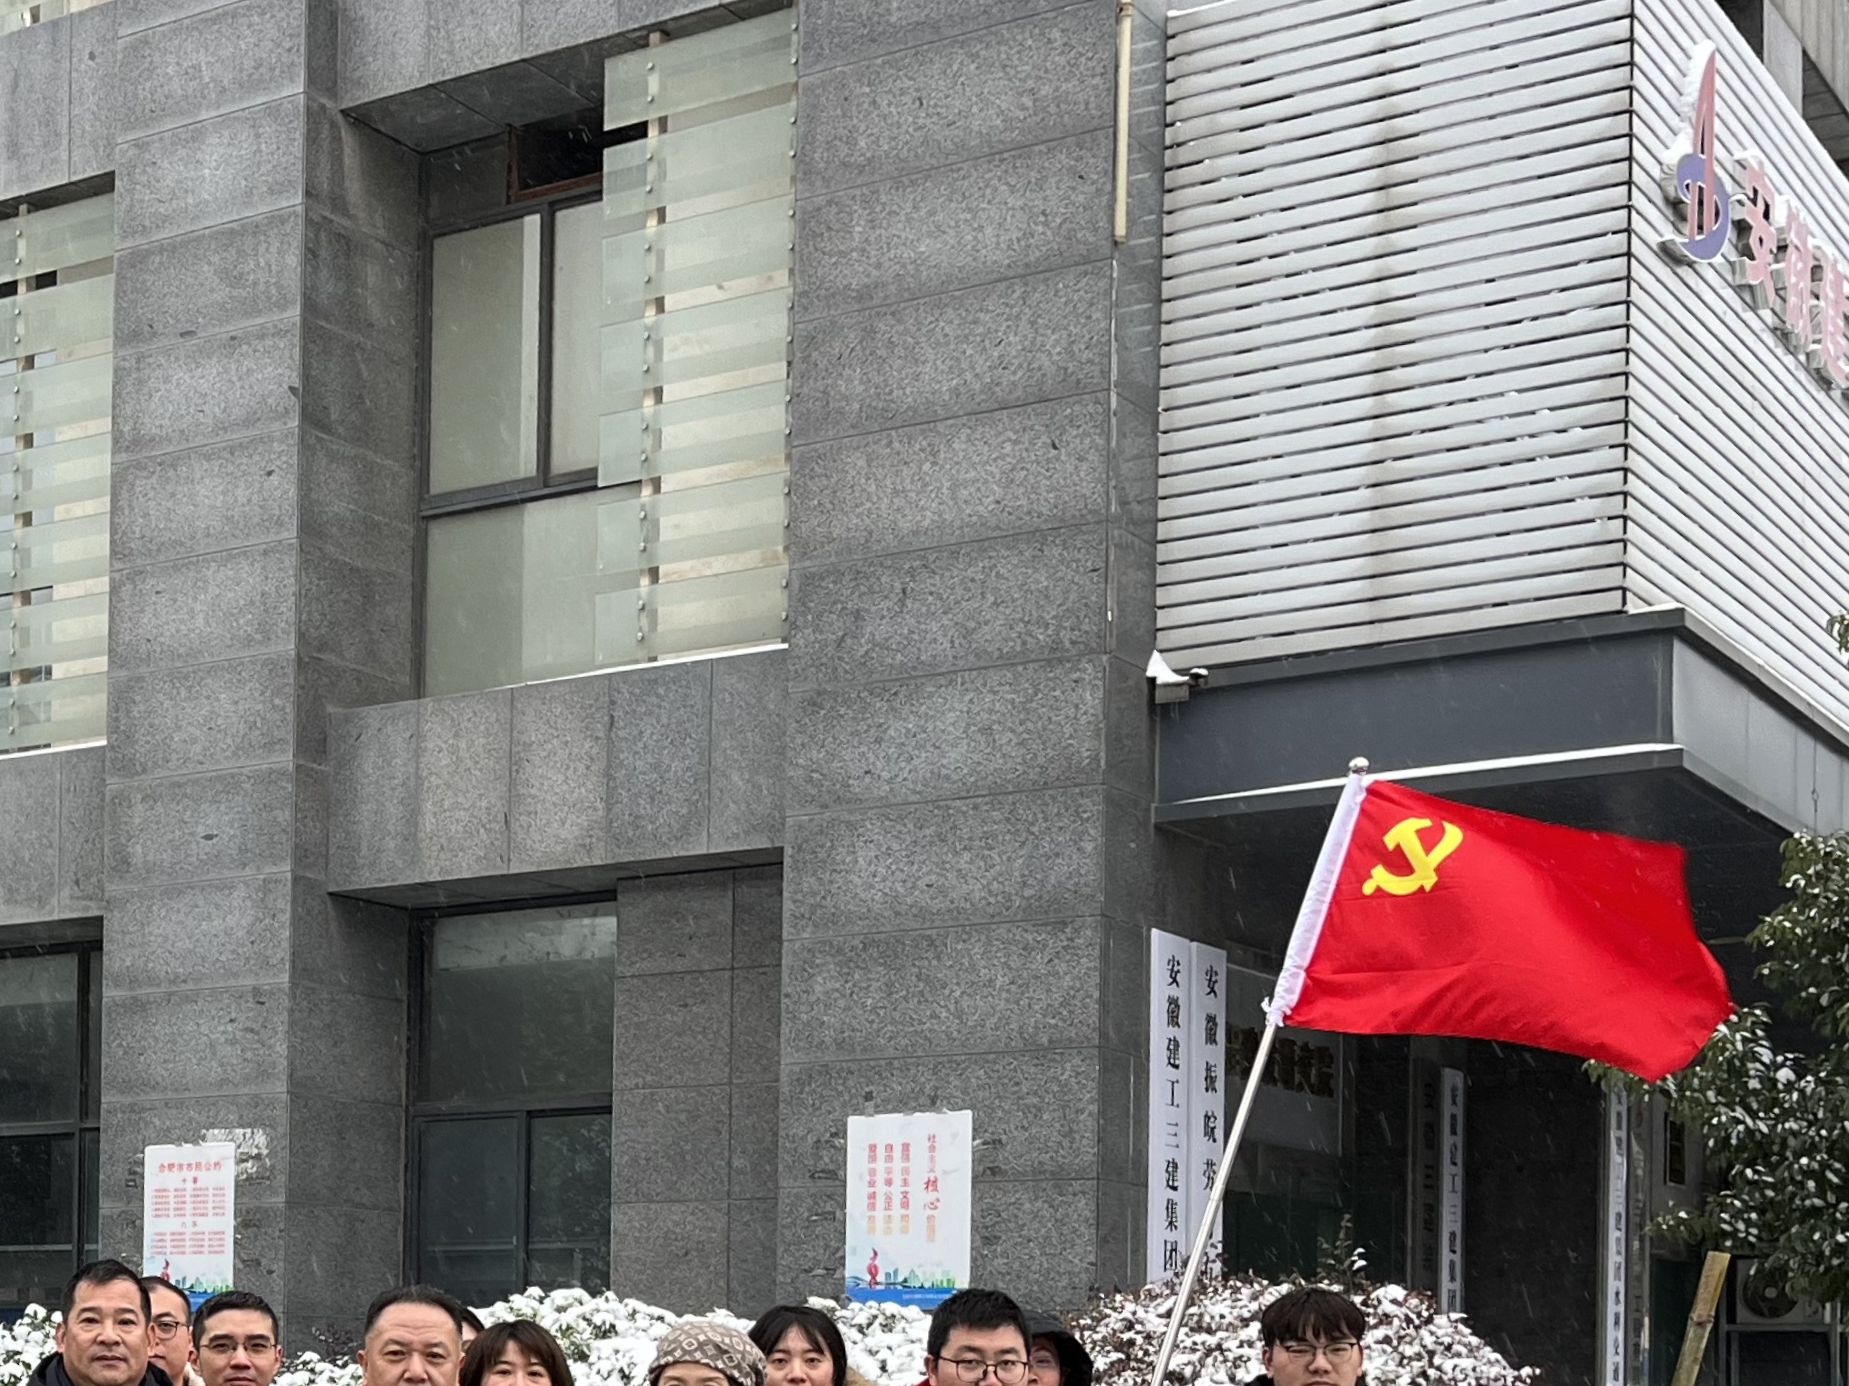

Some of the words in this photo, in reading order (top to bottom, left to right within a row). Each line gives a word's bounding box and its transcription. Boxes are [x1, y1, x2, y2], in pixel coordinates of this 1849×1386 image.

[1164, 954, 1181, 1272] 安徽建工三建集团
